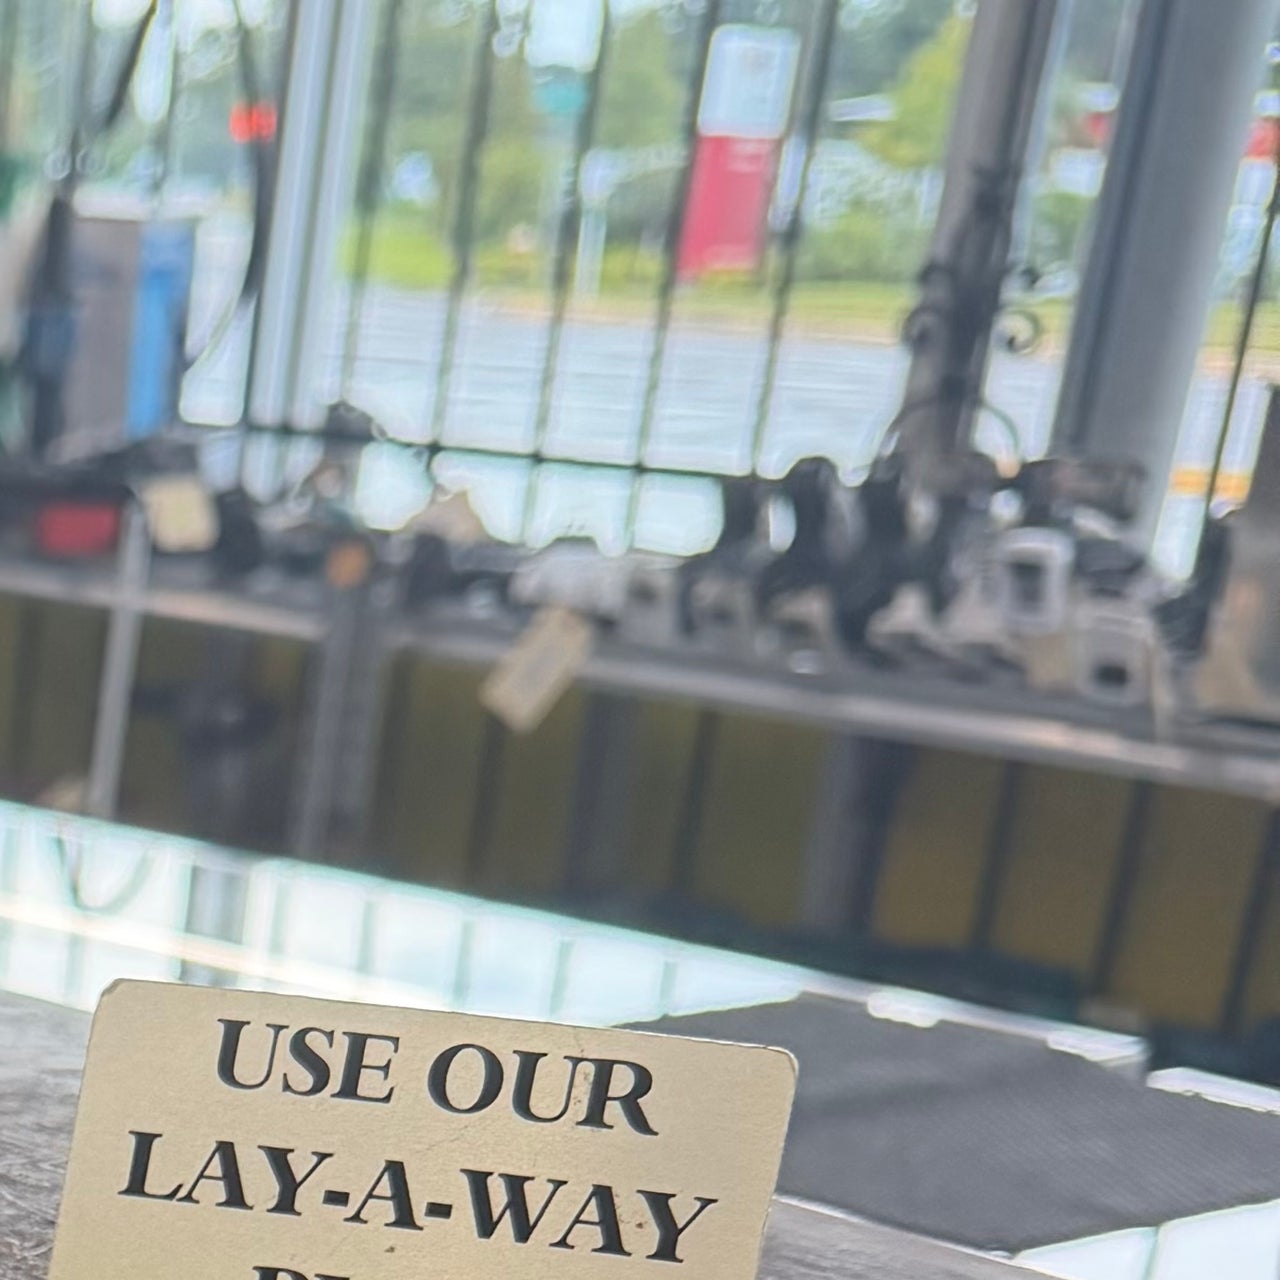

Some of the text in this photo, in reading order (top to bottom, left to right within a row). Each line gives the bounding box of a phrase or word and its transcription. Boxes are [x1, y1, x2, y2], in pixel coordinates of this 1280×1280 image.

[216, 1017, 658, 1137] USE OUR
[117, 1130, 717, 1264] LAY-A-WAY
